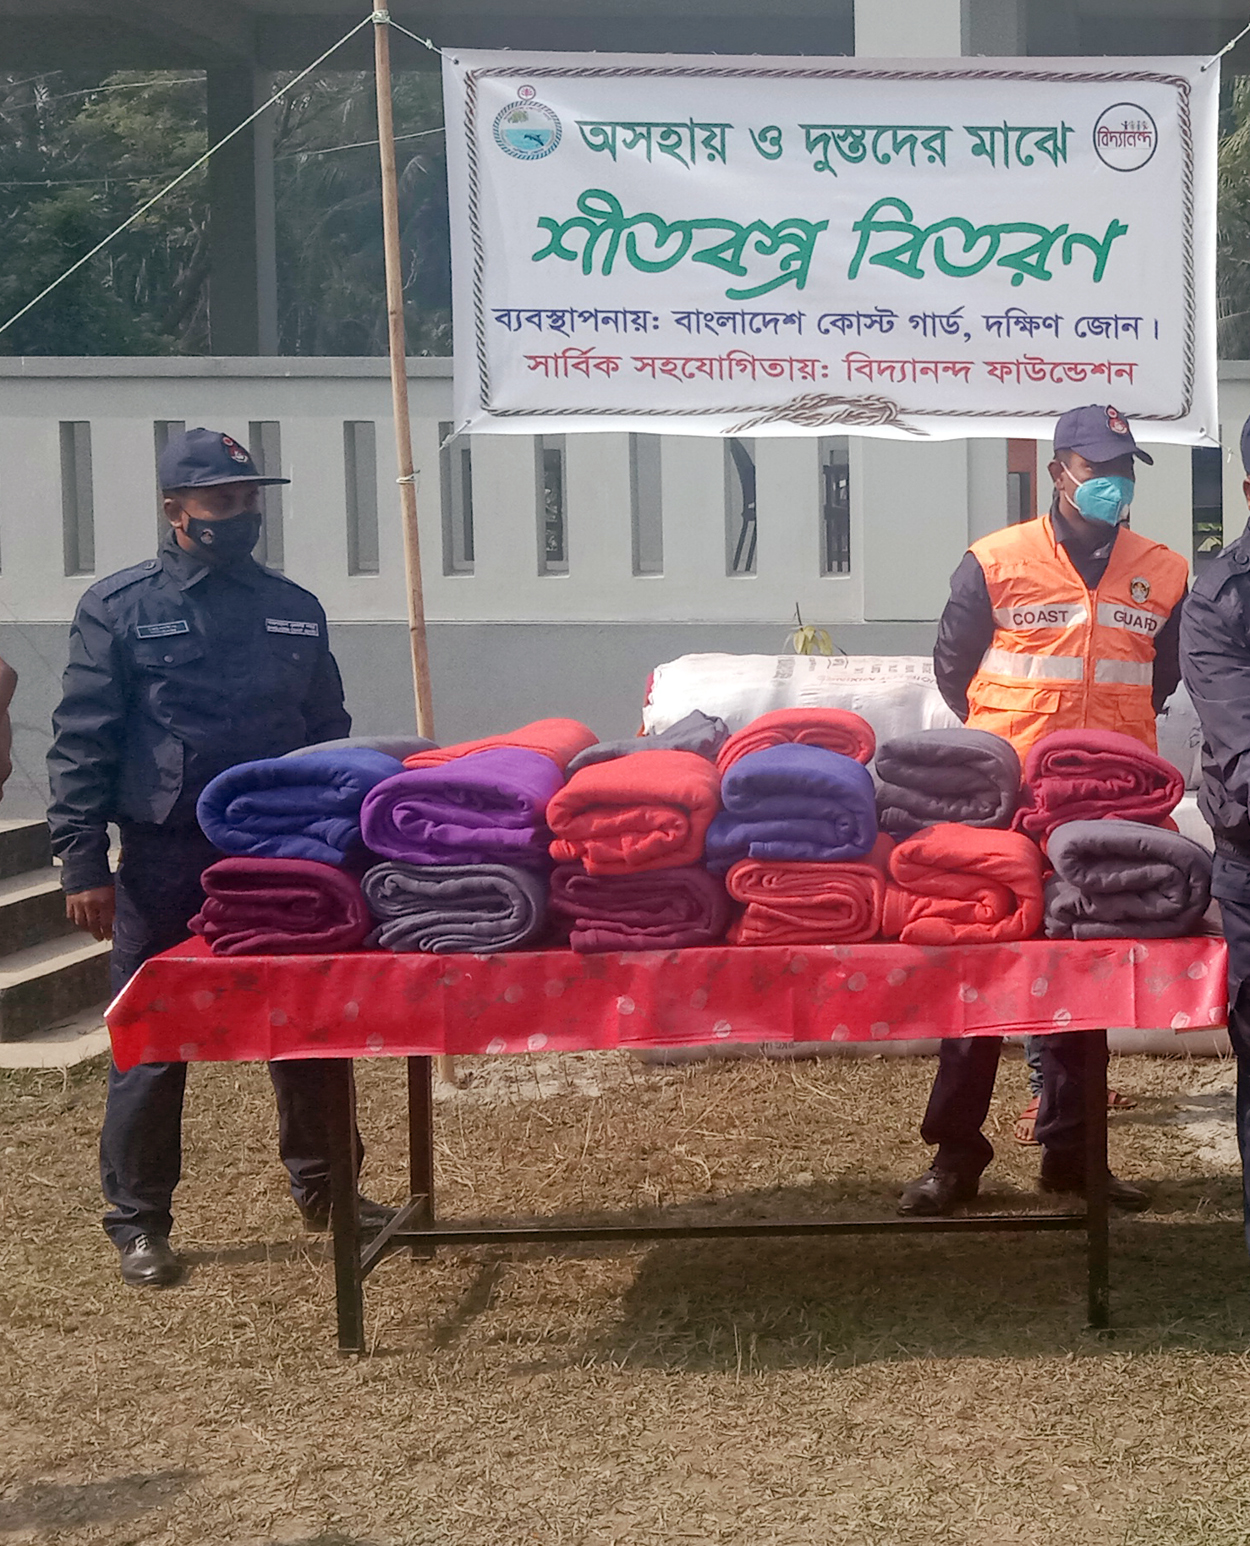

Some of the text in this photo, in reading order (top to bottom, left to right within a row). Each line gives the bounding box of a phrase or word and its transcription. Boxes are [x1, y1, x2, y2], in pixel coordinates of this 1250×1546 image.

[574, 117, 734, 171] অসহায়
[749, 125, 783, 160] ও
[963, 120, 1075, 169] মাঝে
[1097, 126, 1152, 147] বিদ্যানন্দ
[532, 189, 1128, 300] শীতবস্ত্র বিতরণ
[671, 308, 806, 335] বাংলাদেশ
[817, 306, 898, 336] কোস্ট
[981, 307, 1064, 339] দক্ষিণ
[524, 347, 623, 378] সার্বিক
[842, 351, 974, 383] বিদ্যানন্দ
[982, 354, 1138, 385] ফাউন্ডেশন
[1012, 610, 1069, 626] COAST
[1113, 610, 1157, 632] GUARD
